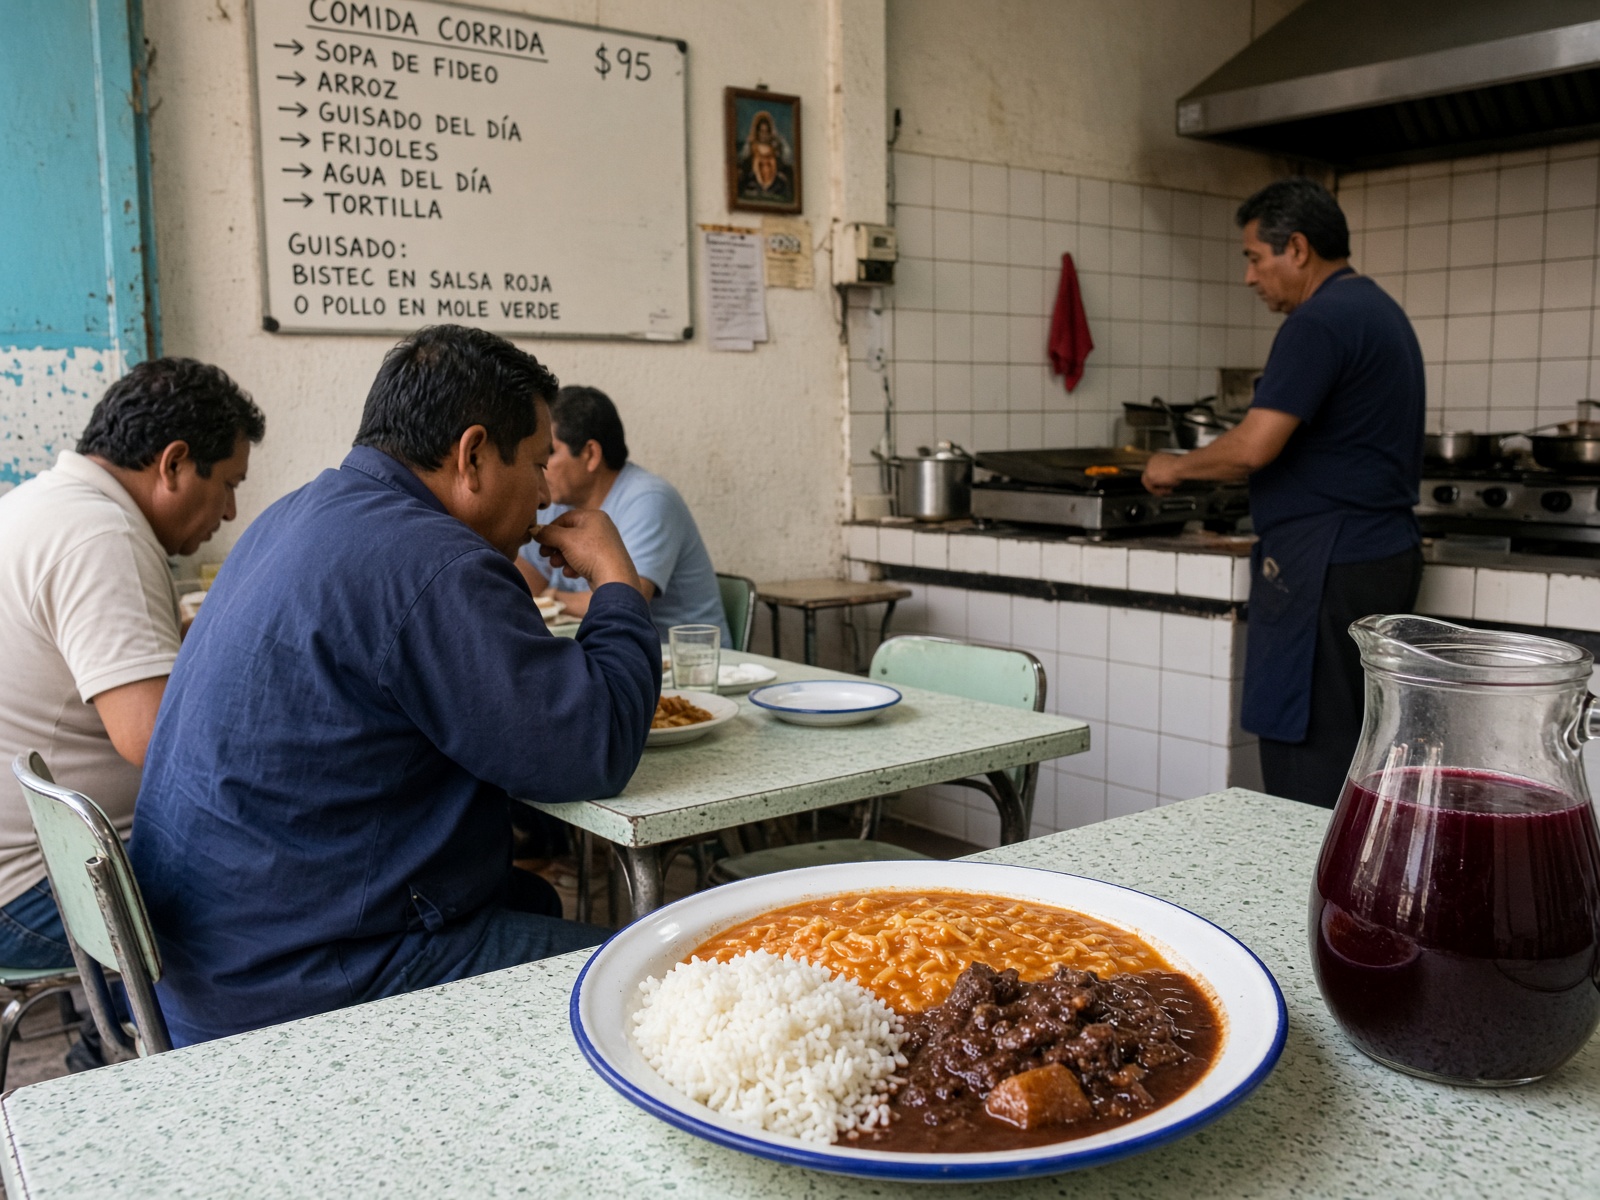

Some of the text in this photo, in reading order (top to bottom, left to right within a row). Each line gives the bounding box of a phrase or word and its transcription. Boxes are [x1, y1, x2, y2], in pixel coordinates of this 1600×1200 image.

[309, 0, 544, 55] COMIDA CORRIDA
[316, 39, 498, 84] SOPA DE FIDEO
[595, 43, 651, 81] $95
[317, 71, 398, 100] ARROZ
[319, 101, 522, 142] GUISADO DEL DÍA
[322, 132, 438, 162] FRIJOLES
[323, 162, 492, 194] AGUA DEL DÍA
[323, 192, 442, 219] TORTILLA
[288, 232, 406, 259] GUISADO:
[292, 263, 552, 292] BISTEC EN SALSA ROJA
[294, 295, 560, 320] O POLLO EN MOLE VERDE
